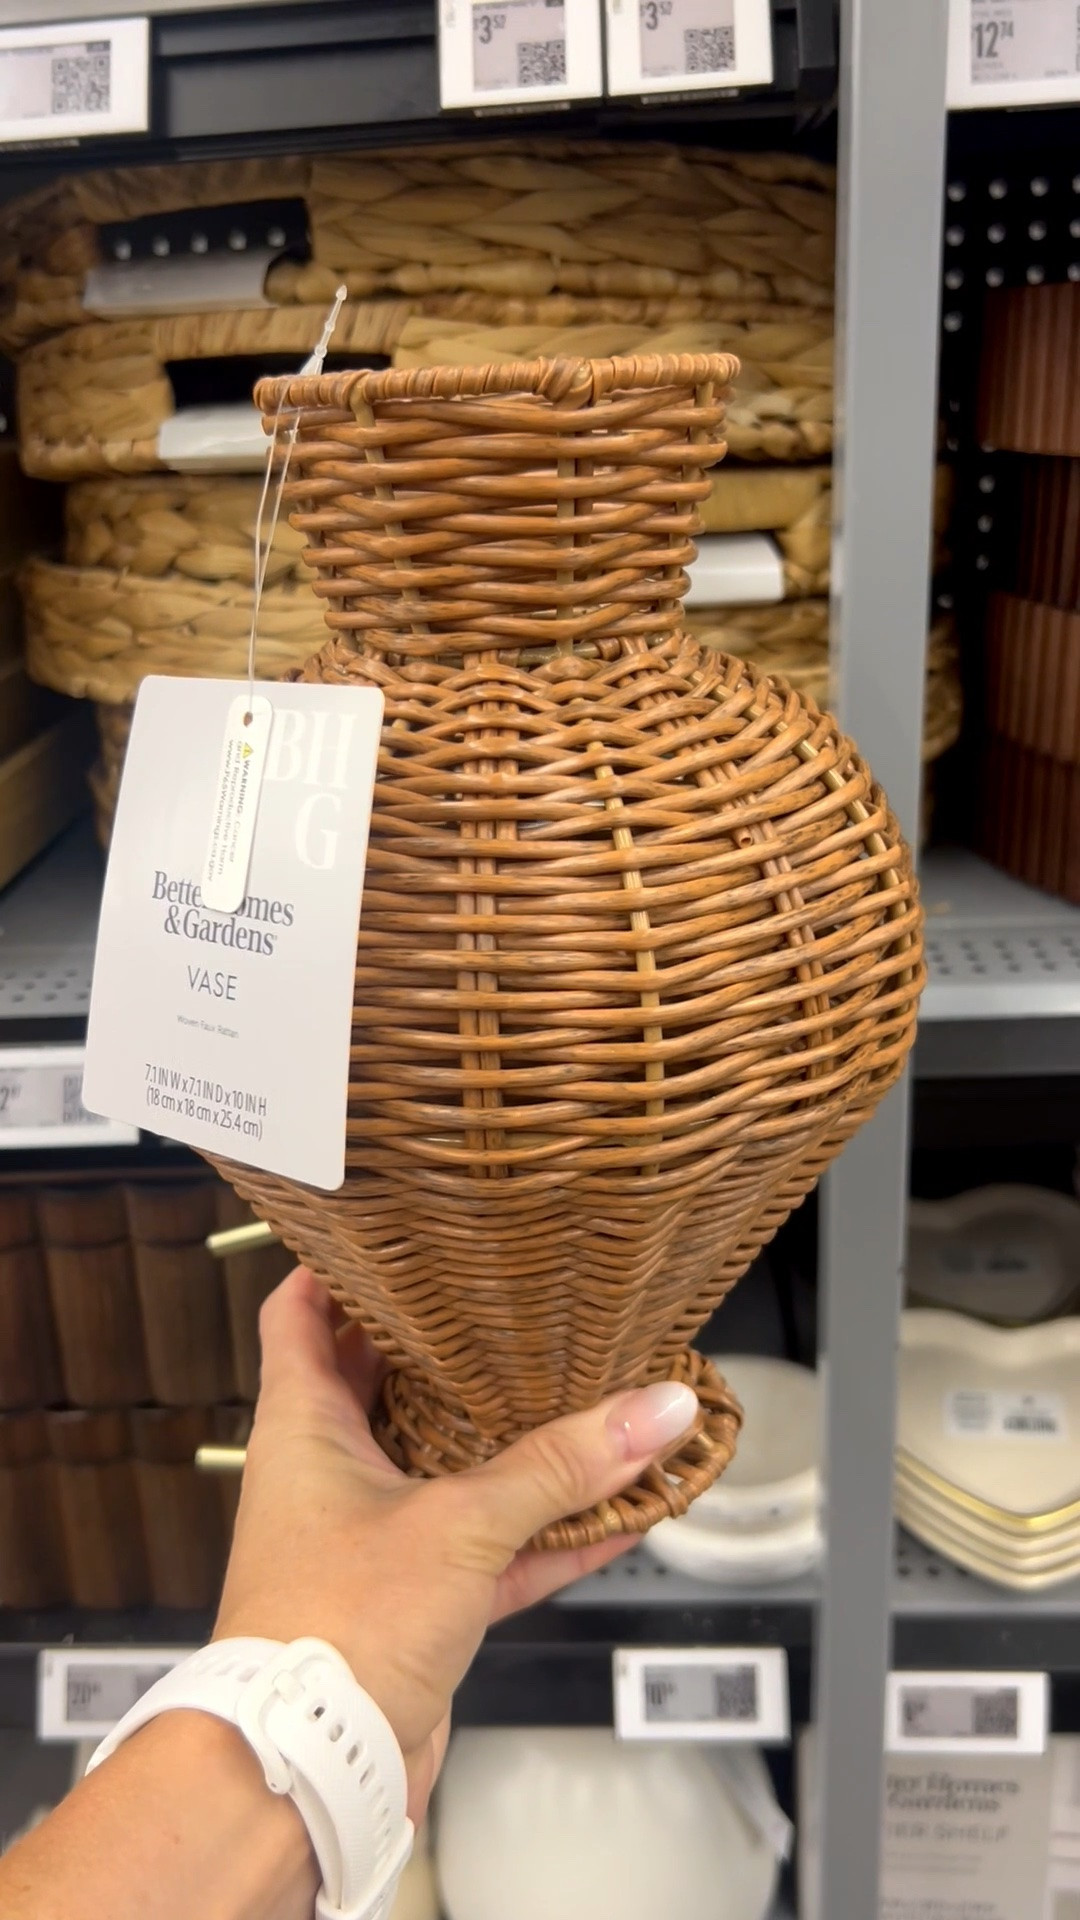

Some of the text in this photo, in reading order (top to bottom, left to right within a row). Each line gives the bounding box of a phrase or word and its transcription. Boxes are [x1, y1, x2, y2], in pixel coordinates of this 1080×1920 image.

[152, 870, 295, 927] Bette omes
[187, 965, 237, 1001] VASE
[161, 1095, 176, 1112] cm
[185, 1098, 195, 1118] 18
[196, 1106, 211, 1123] cm
[220, 1108, 242, 1133] 25.4
[215, 1084, 223, 1103] D
[232, 1090, 244, 1110] 10
[258, 1097, 267, 1117] H
